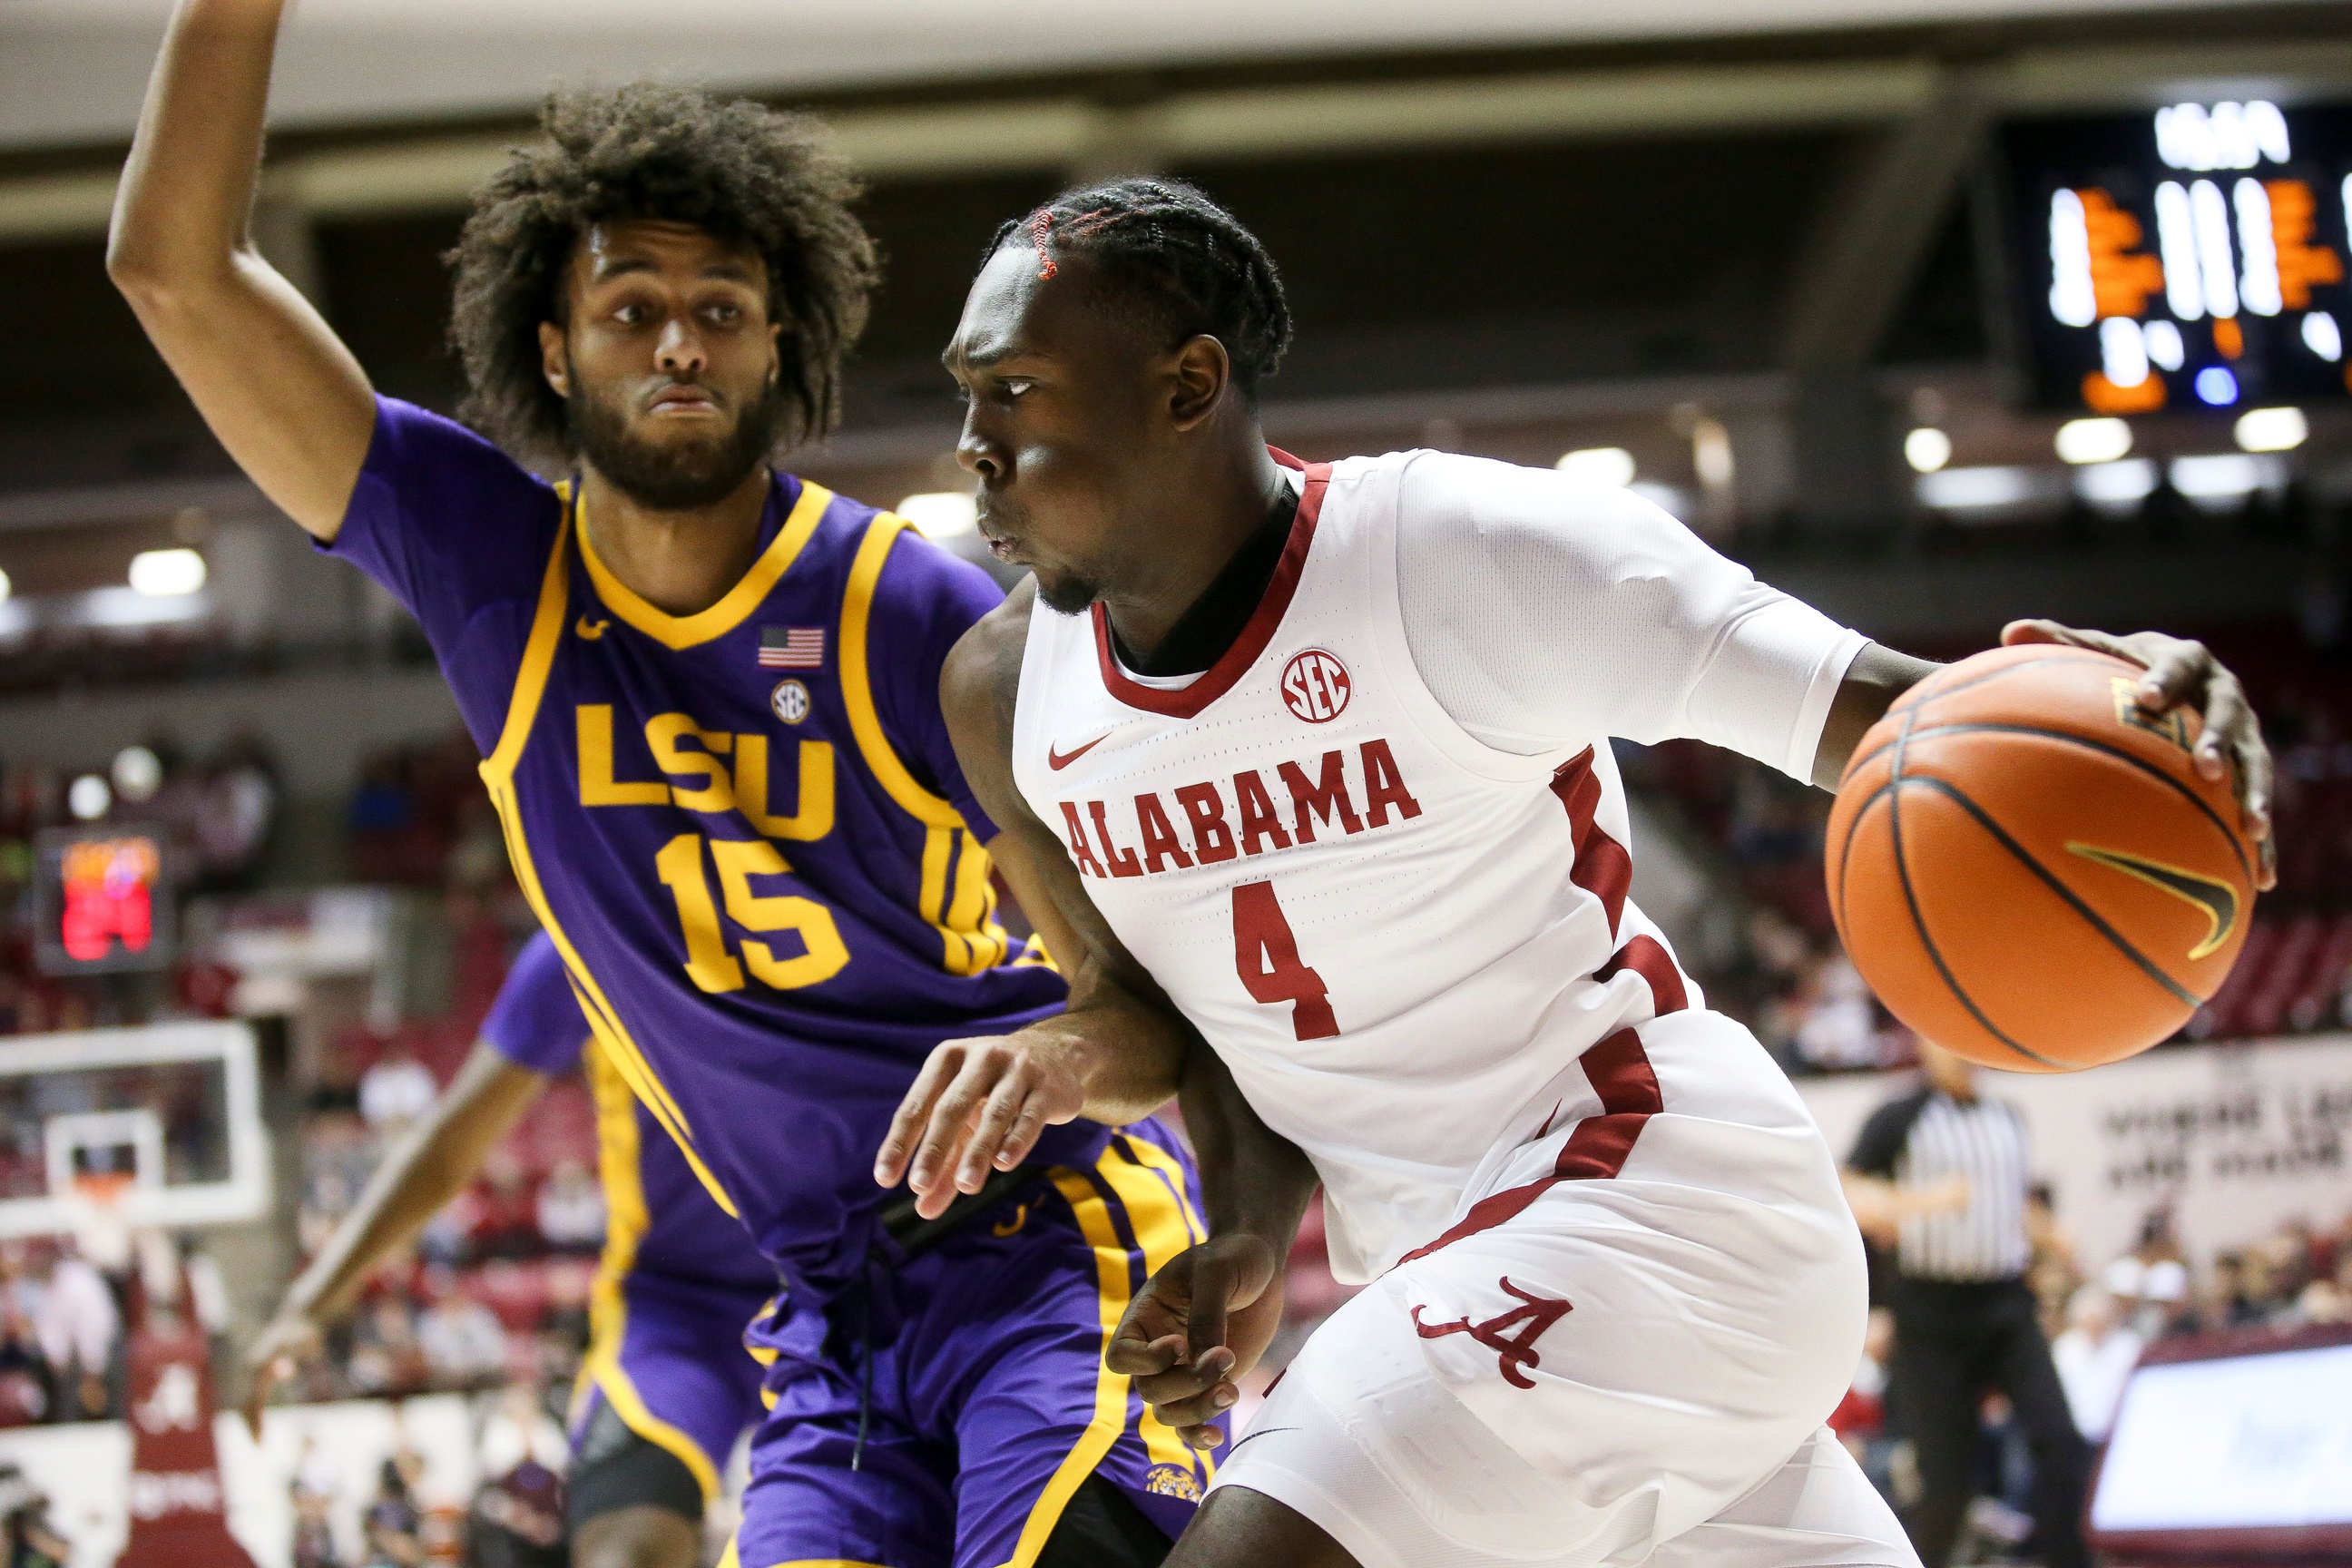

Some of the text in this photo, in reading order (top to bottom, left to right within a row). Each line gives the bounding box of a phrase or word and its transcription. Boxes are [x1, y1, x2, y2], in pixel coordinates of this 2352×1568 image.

[772, 682, 808, 721] SEC
[1282, 652, 1351, 720] SEC
[575, 703, 836, 842] LSU
[1058, 738, 1423, 878] ALABAMA
[655, 833, 851, 995] 15
[1231, 880, 1341, 1042] 4
[1411, 1275, 1574, 1390] A
